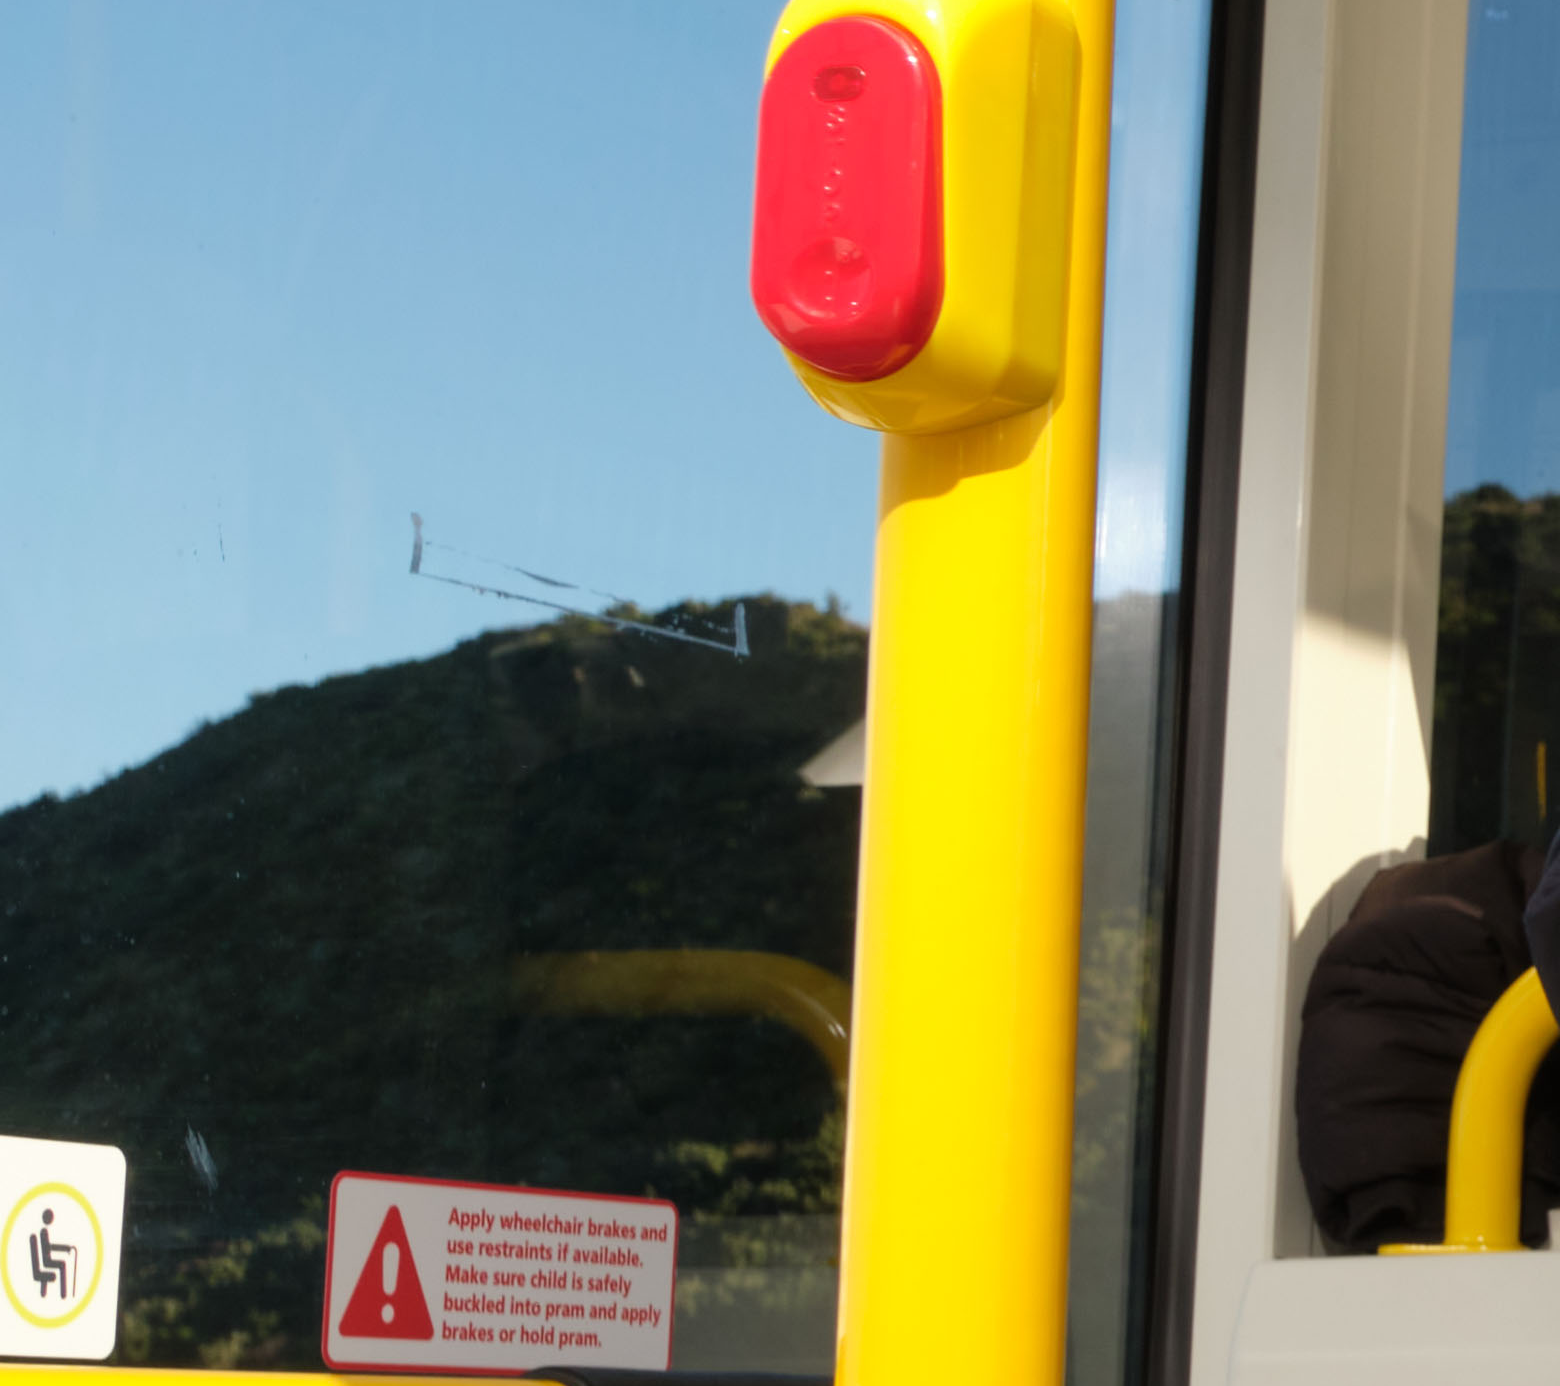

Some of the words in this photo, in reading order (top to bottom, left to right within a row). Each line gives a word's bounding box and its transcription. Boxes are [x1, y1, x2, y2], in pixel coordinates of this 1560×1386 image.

[448, 1207, 495, 1233] Apply
[500, 1211, 584, 1236] wheelchair
[587, 1217, 636, 1240] brakes
[640, 1223, 668, 1242] and
[447, 1240, 474, 1255] use
[478, 1240, 553, 1261] restraints
[557, 1242, 569, 1261] if
[573, 1246, 643, 1267] available.
[445, 1264, 488, 1285] Make
[493, 1271, 526, 1287] sure
[530, 1269, 567, 1289] child
[572, 1272, 583, 1291] is
[588, 1273, 632, 1298] safely
[443, 1292, 505, 1314] buckled
[510, 1295, 541, 1316] into
[545, 1302, 585, 1321] pram
[589, 1302, 617, 1320] and
[621, 1304, 661, 1328] apply
[442, 1320, 494, 1342] brakes
[499, 1328, 516, 1343] or
[520, 1325, 555, 1345] hold
[559, 1332, 602, 1350] pram.
